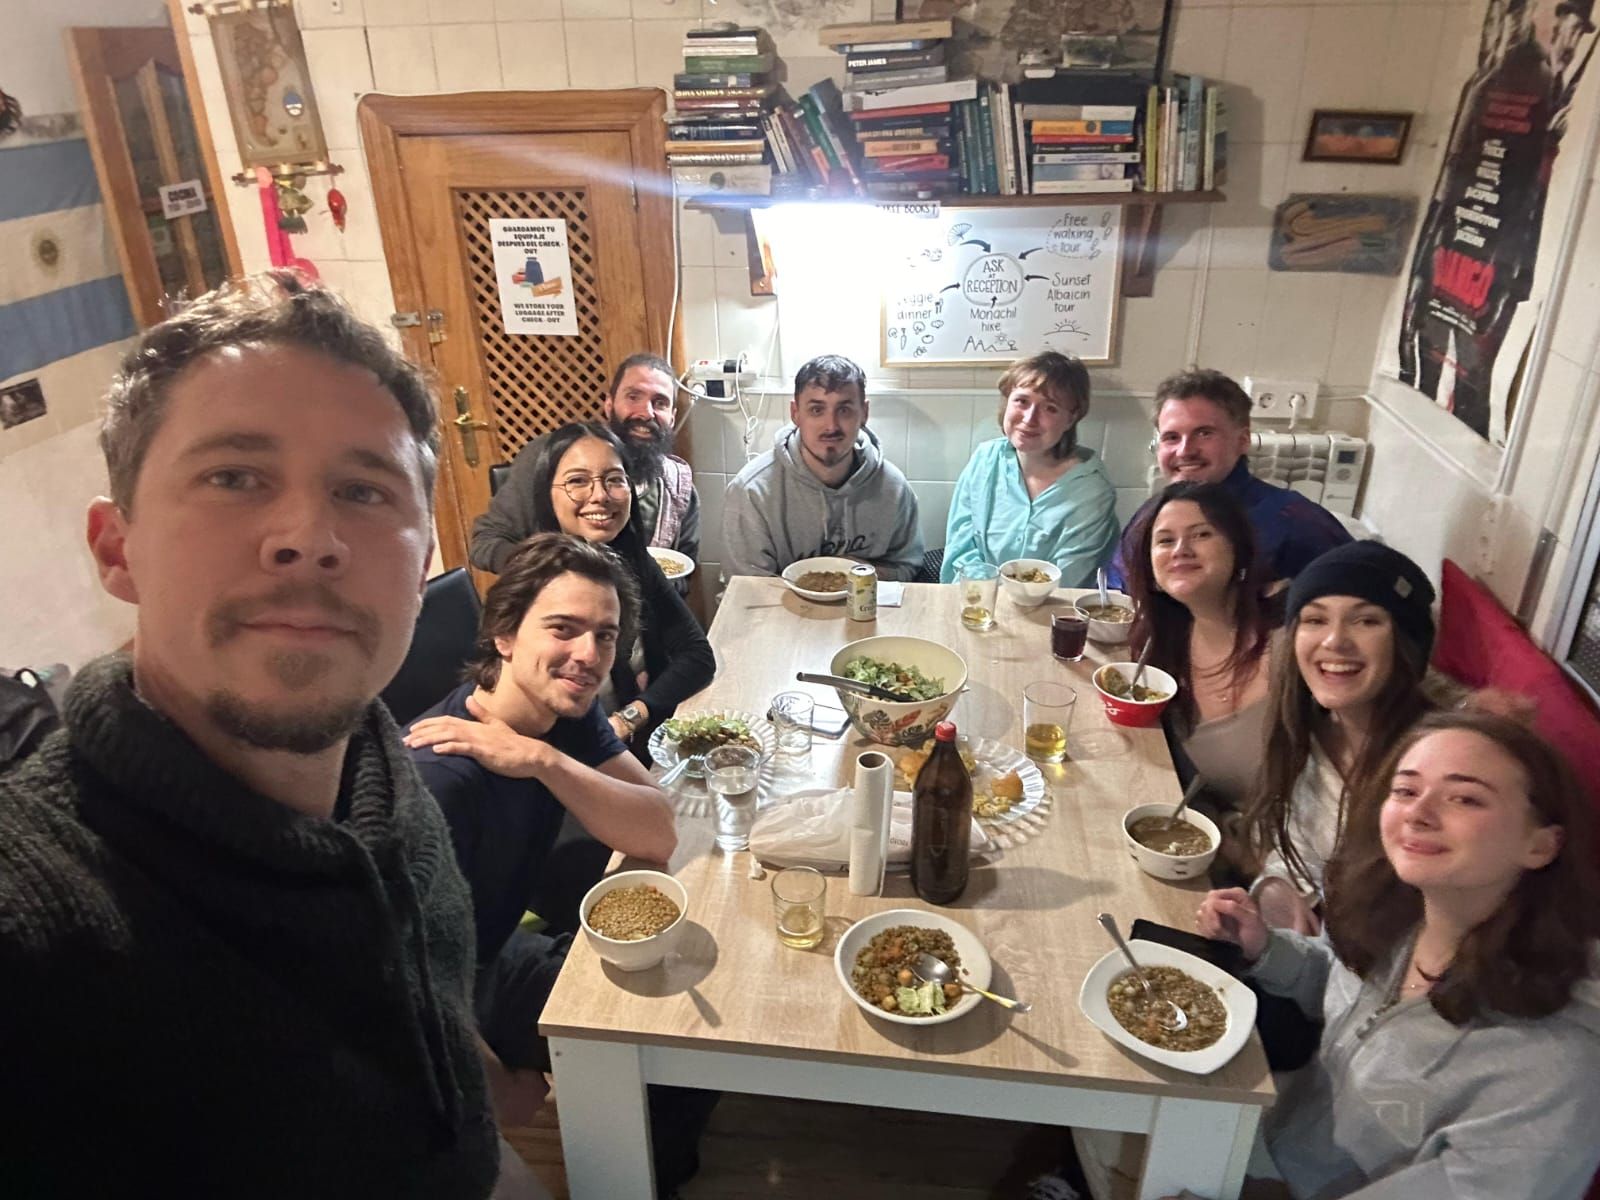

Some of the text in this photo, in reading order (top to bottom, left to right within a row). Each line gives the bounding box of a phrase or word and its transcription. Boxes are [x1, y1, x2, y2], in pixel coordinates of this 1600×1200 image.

[848, 60, 867, 68] PETER
[868, 58, 887, 66] JAMES
[904, 204, 930, 214] BOOKS
[1054, 228, 1094, 242] walking
[1060, 242, 1081, 253] tour
[983, 259, 1005, 273] ASK
[1052, 272, 1091, 287] Sunset
[966, 279, 1018, 294] RECEPTION
[970, 307, 1017, 320] Monachil
[1054, 303, 1075, 313] tour
[981, 322, 1001, 332] hike
